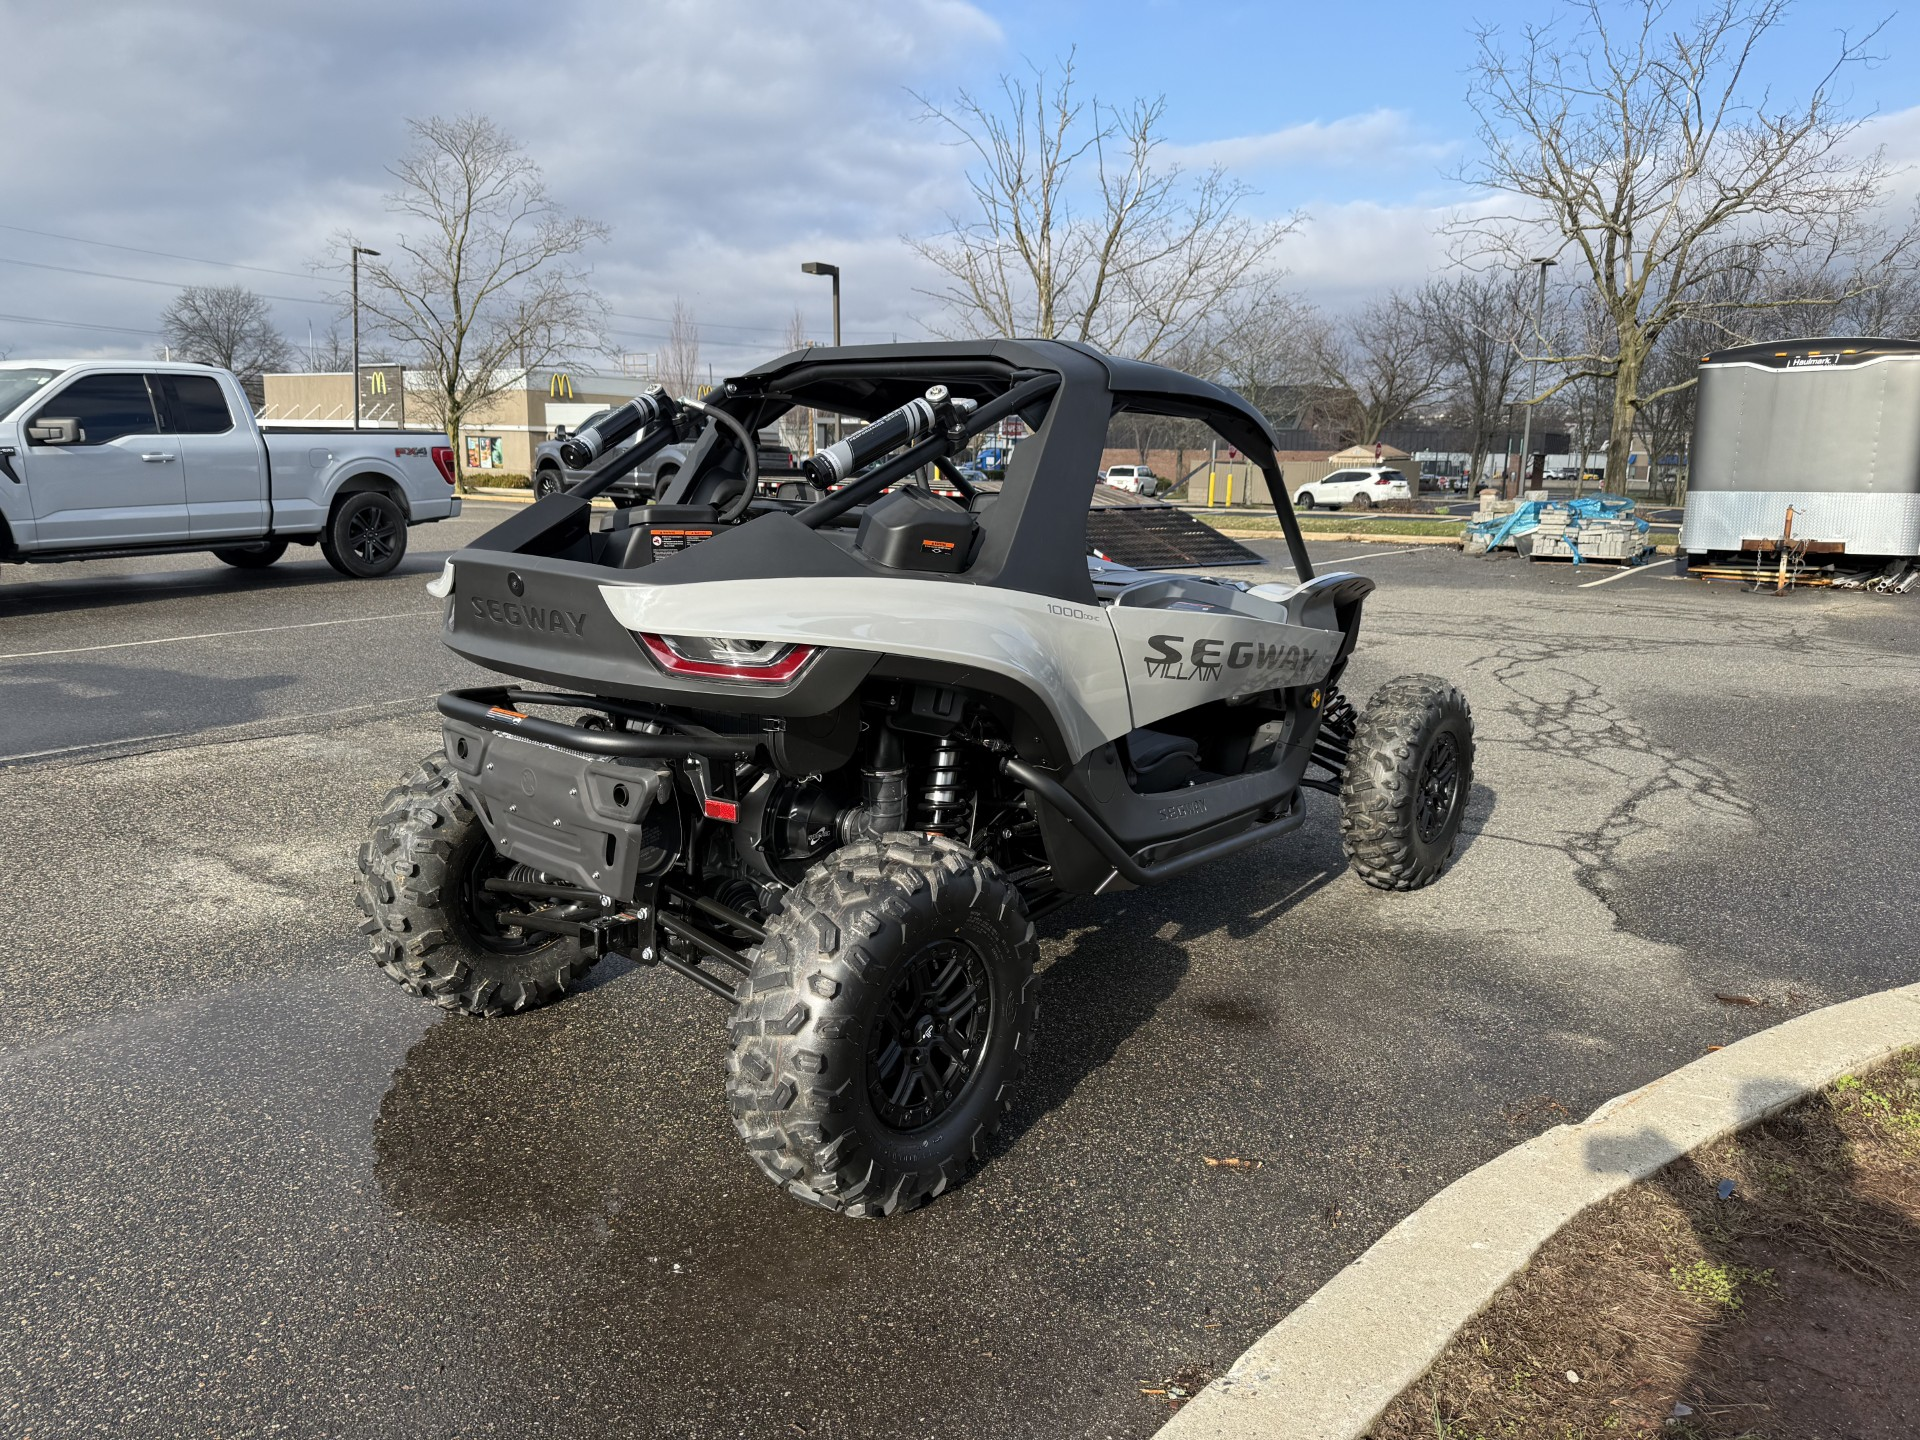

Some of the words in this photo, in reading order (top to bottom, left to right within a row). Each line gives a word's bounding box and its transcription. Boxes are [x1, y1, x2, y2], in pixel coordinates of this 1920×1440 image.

[371, 371, 387, 395] M
[550, 373, 573, 399] M
[395, 447, 427, 457] FX4
[471, 596, 586, 637] SEGWAY
[1047, 603, 1083, 619] 1000
[1144, 634, 1318, 672] SEGWAY
[1145, 662, 1223, 682] VILLAIN
[1158, 798, 1208, 821] SEGWAY
